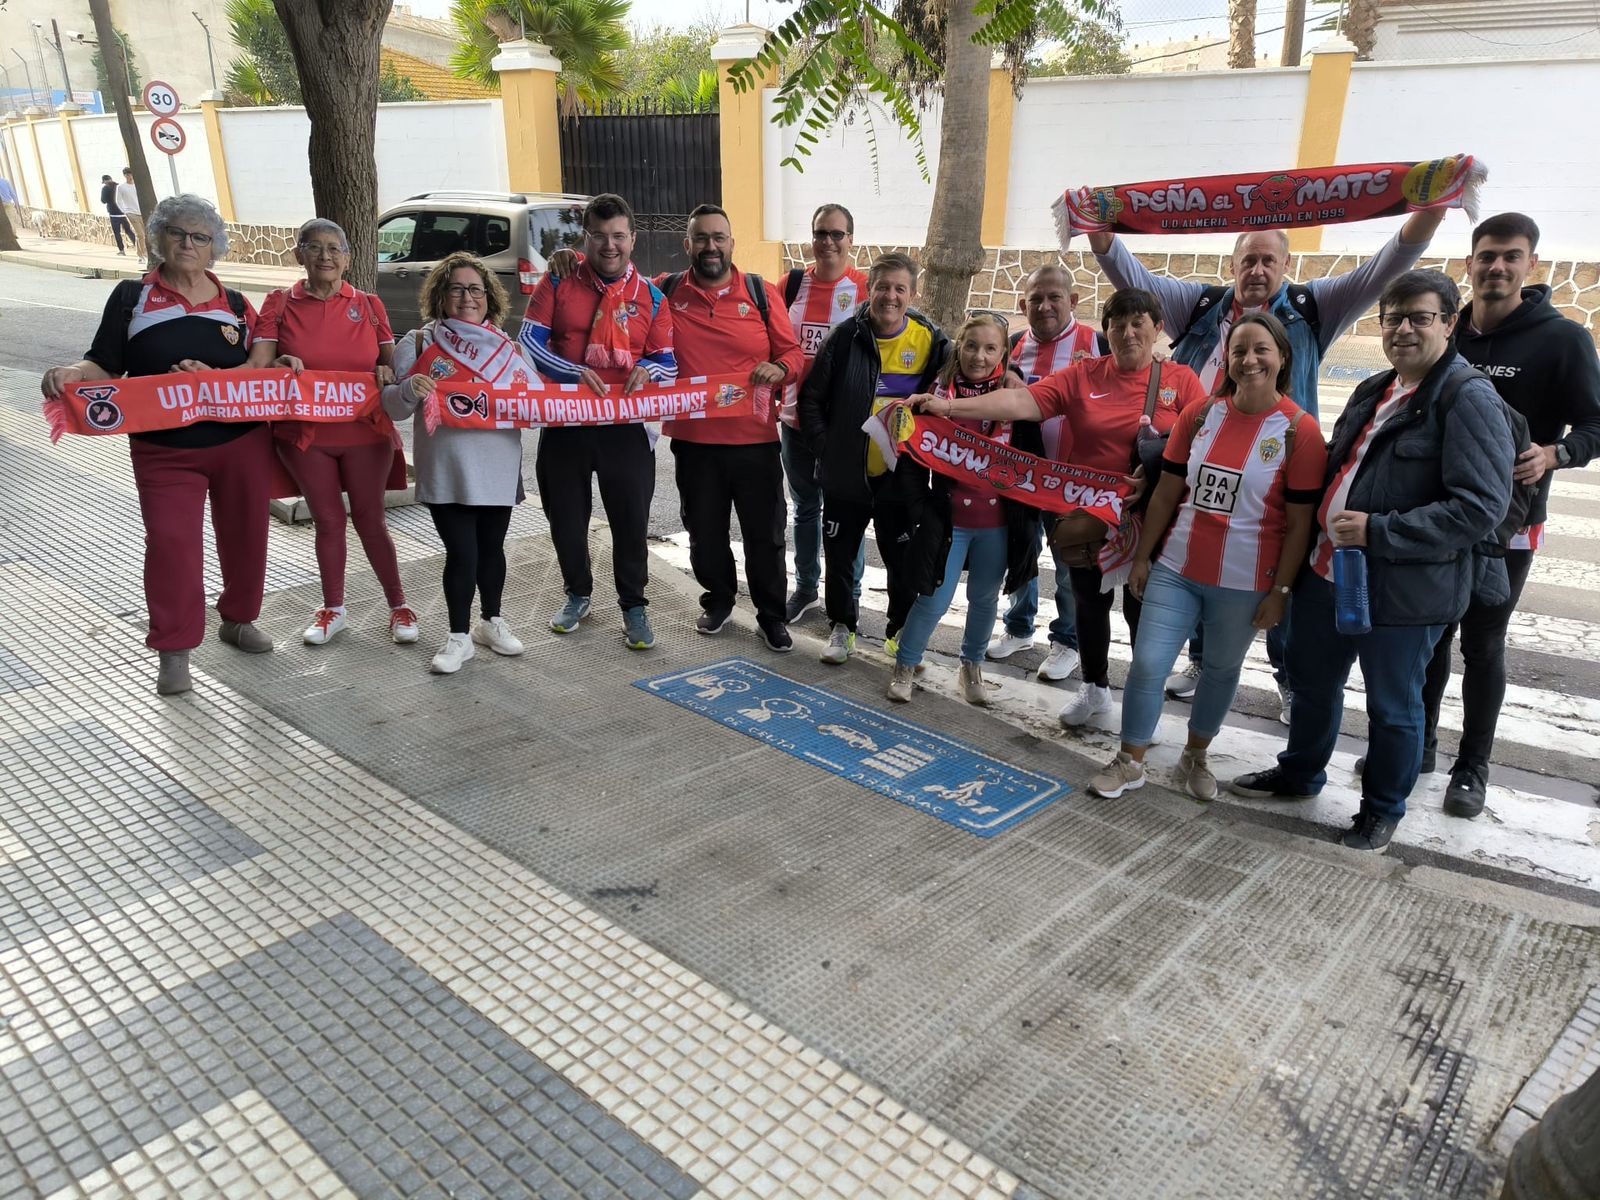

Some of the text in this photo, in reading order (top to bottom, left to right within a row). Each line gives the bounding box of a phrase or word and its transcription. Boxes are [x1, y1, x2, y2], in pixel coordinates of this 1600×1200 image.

[151, 92, 173, 106] 30
[1127, 183, 1207, 213] PEÑA
[1212, 194, 1233, 210] EL
[1241, 212, 1293, 226] FUNDADA
[1297, 211, 1313, 222] EN
[1317, 207, 1345, 219] 1999
[156, 373, 367, 410] UD ALMERÍA FANS
[181, 403, 354, 422] ALMERIA NUNCA SE RINDE
[495, 391, 708, 422] PEÑA ORGULLO ALMERIENSE
[954, 429, 976, 443] 1999
[978, 439, 992, 450] EN
[1042, 474, 1063, 491] EL
